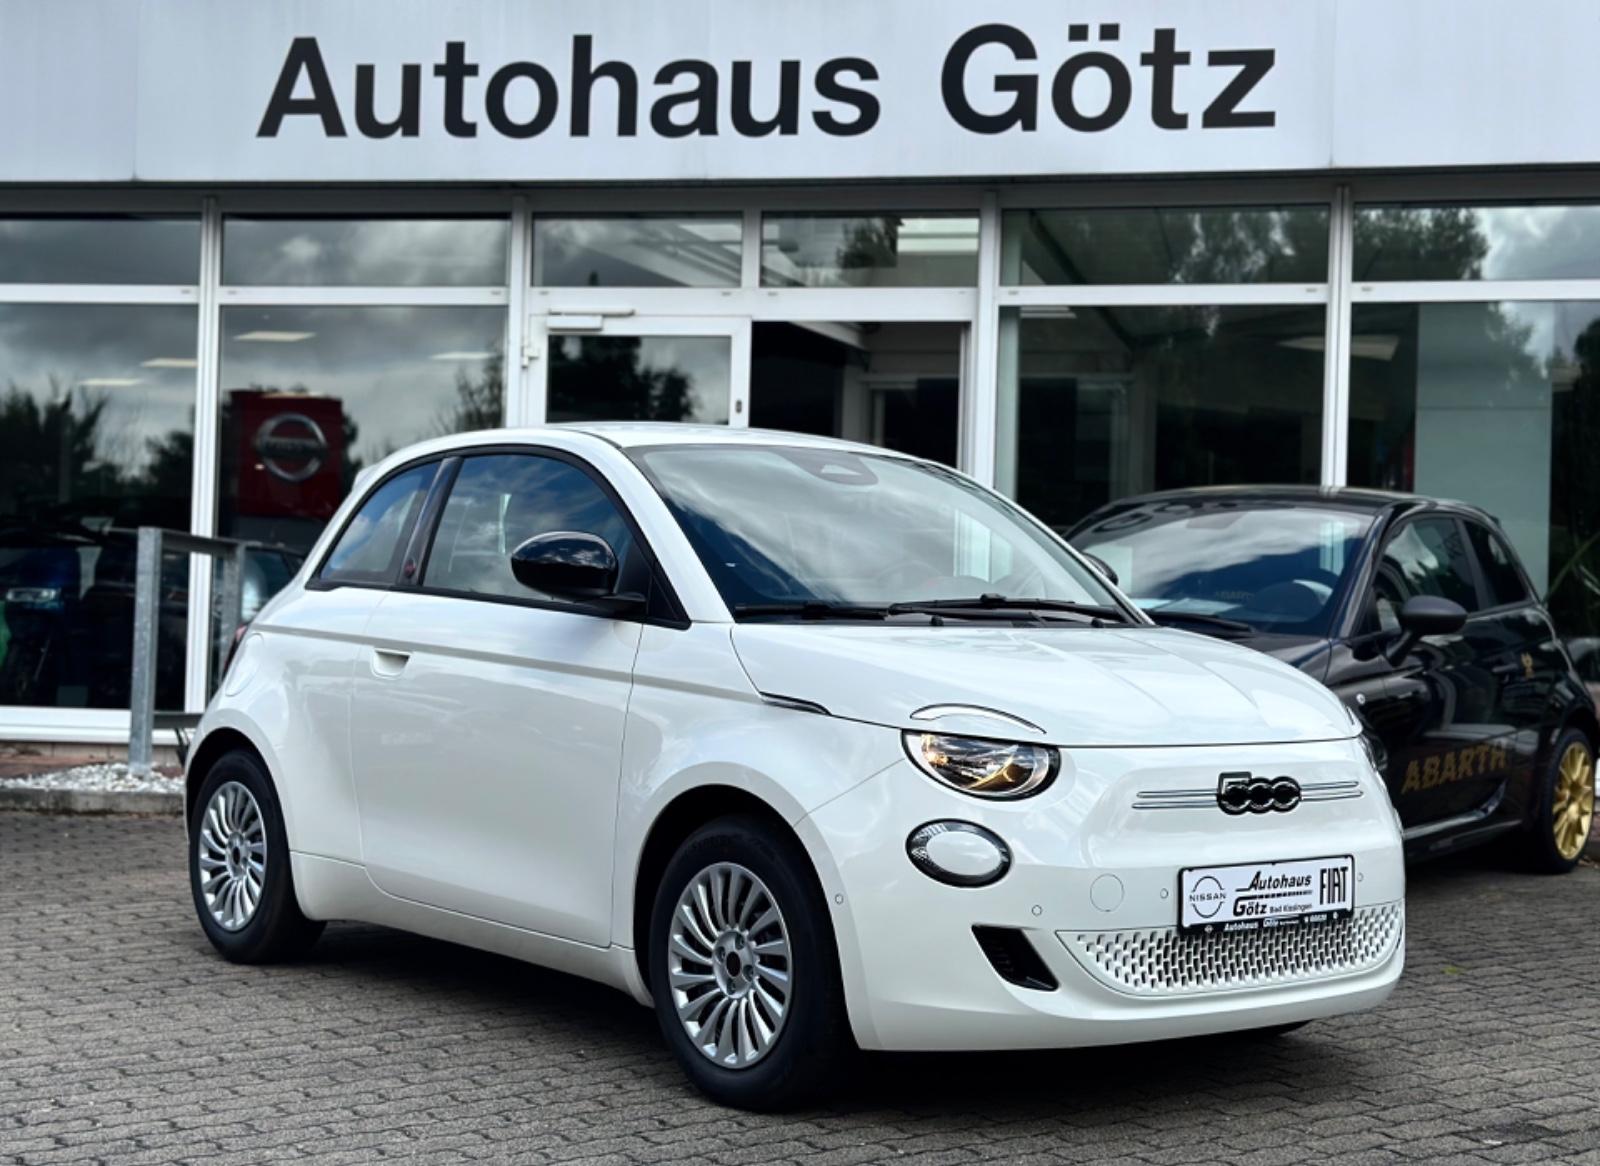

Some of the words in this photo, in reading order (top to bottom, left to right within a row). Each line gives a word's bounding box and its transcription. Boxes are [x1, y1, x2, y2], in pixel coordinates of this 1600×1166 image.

[257, 35, 881, 139] Autohaus
[941, 23, 1277, 133] Götz
[1400, 744, 1506, 795] ABARTH
[1218, 772, 1301, 815] 500
[1189, 892, 1227, 902] NISSAN
[1236, 870, 1313, 892] Autohaus
[1319, 866, 1349, 906] FIAT
[1233, 896, 1268, 917] Götz
[1269, 905, 1283, 914] Bad
